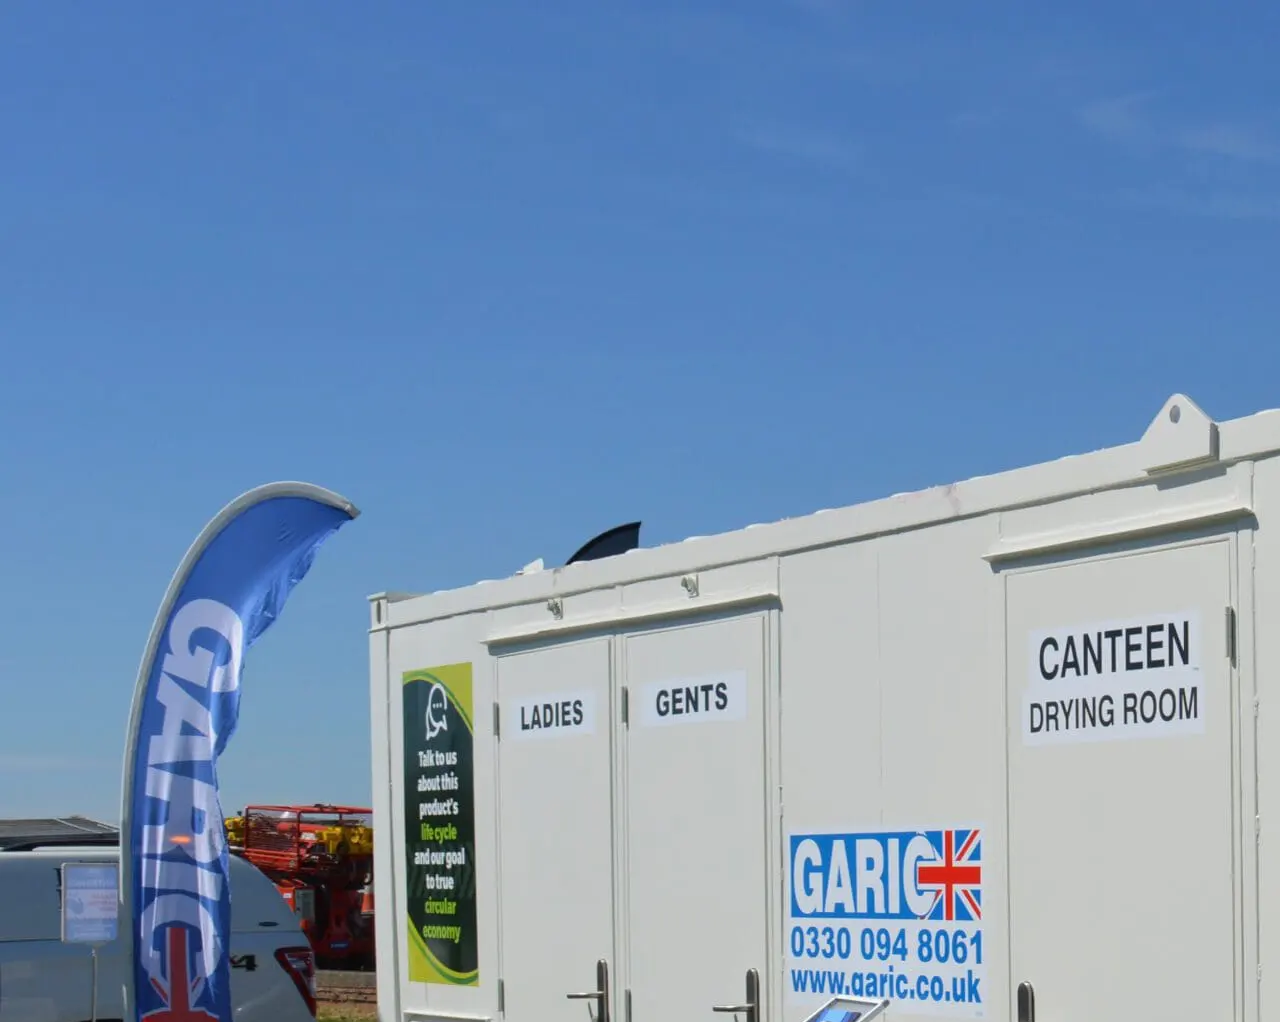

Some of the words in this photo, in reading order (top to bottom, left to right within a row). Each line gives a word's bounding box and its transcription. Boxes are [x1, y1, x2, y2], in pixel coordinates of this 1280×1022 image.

[1039, 620, 1189, 681] CANTEEN
[655, 682, 728, 717] GENTS
[1030, 694, 1115, 734] DRYING
[1123, 686, 1198, 725] ROOM
[520, 699, 584, 731] LADIES
[418, 749, 435, 767] Talk
[435, 750, 445, 766] to
[446, 751, 457, 765] us
[140, 598, 244, 980] GARIC
[417, 774, 441, 792] about
[441, 771, 458, 790] this
[421, 822, 434, 841] life
[434, 822, 457, 845] cycle
[414, 848, 430, 865] and
[430, 851, 446, 865] our
[446, 847, 465, 869] goal
[426, 873, 436, 889] to
[436, 873, 455, 890] true
[793, 834, 936, 917] GARIC
[424, 896, 456, 915] circular
[422, 925, 461, 944] economy
[791, 926, 851, 960] 0330
[860, 927, 907, 961] 094
[917, 929, 982, 965] 8061
